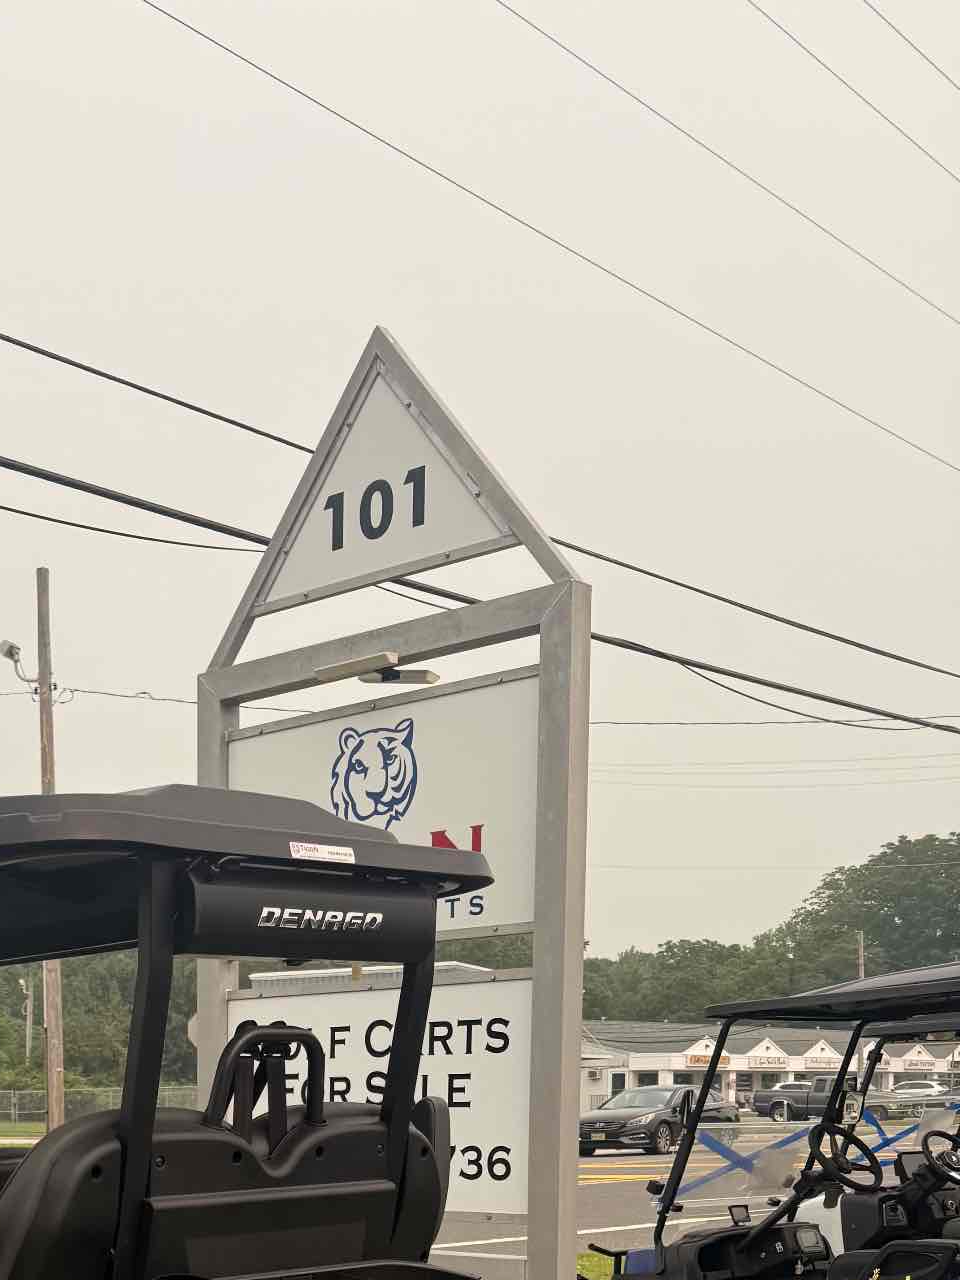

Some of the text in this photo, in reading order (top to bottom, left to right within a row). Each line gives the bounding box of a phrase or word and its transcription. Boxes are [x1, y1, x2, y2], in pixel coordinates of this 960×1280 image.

[324, 465, 426, 552] 101
[257, 906, 384, 931] DENAGO
[364, 1017, 510, 1058] CRTS
